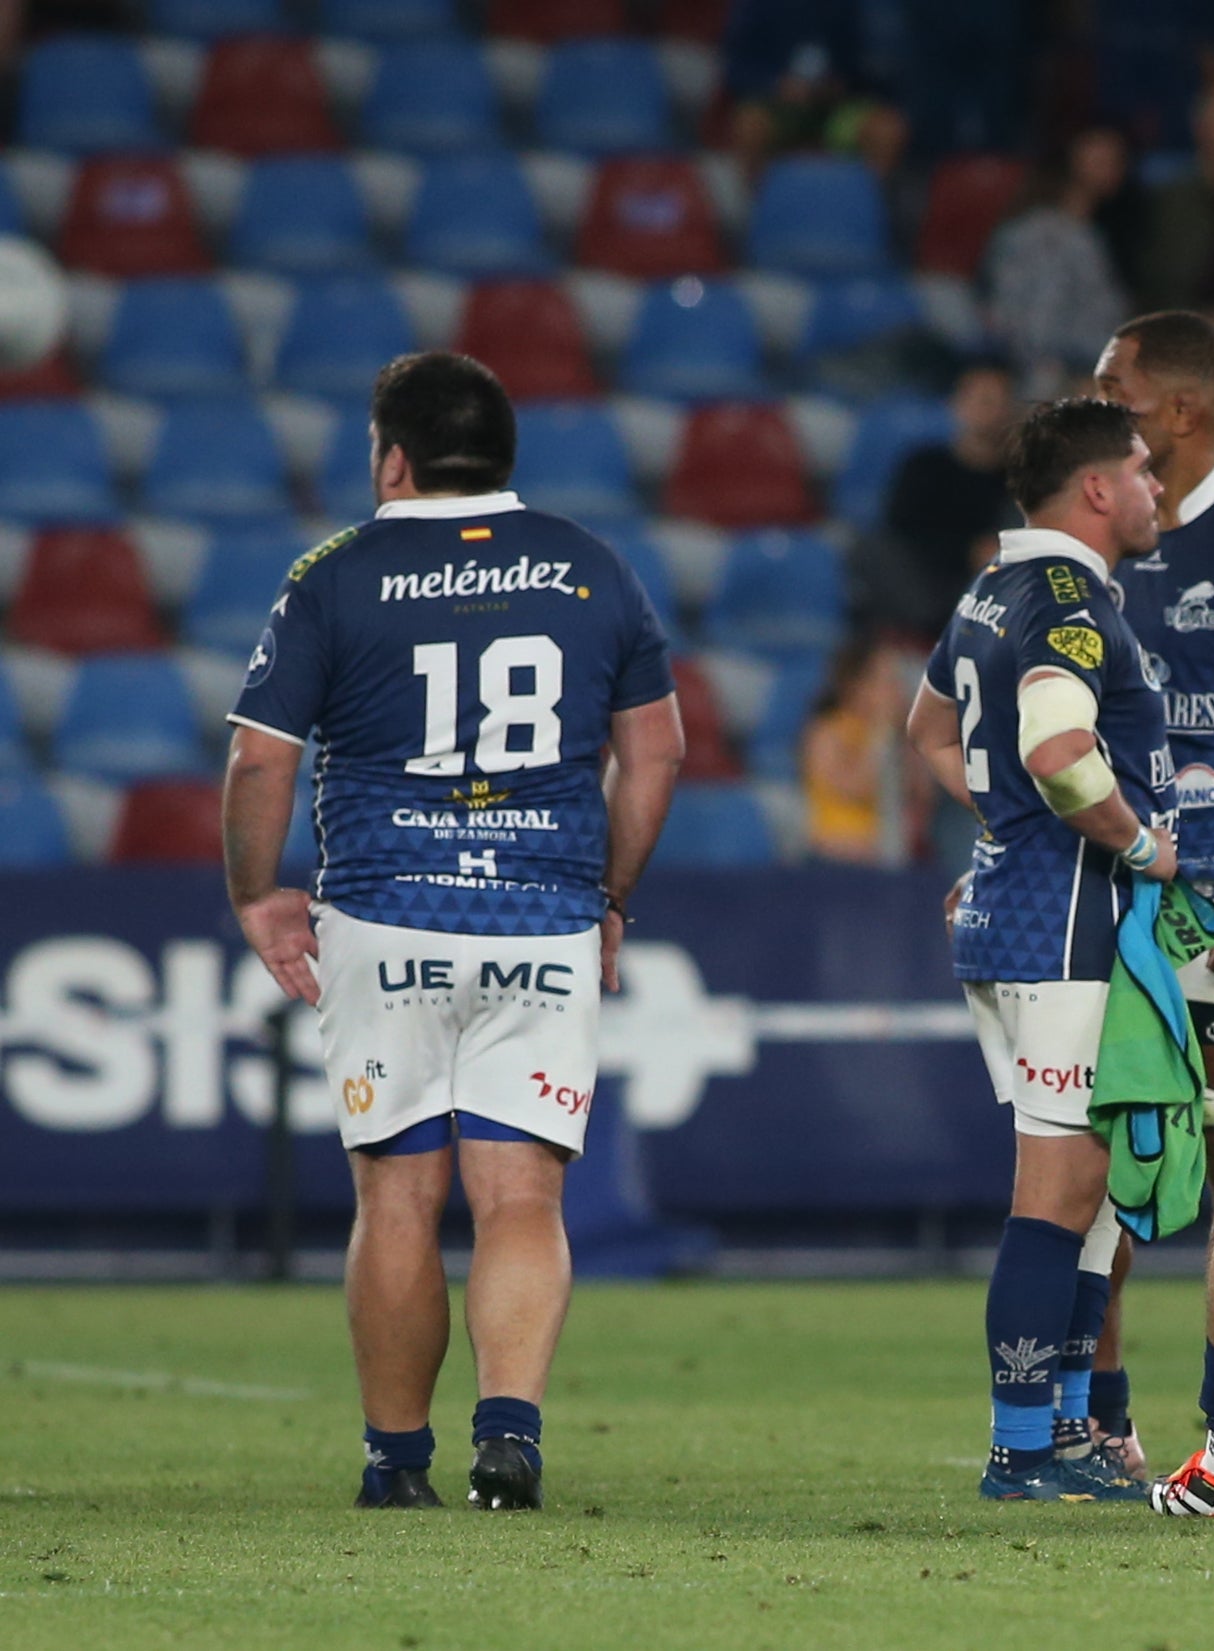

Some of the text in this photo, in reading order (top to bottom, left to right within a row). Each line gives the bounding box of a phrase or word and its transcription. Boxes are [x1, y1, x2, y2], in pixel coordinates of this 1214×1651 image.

[404, 634, 563, 777] 18
[954, 656, 990, 793] 2
[392, 808, 558, 830] CAJA RURAL
[433, 828, 517, 842] DE ZAMORA
[995, 1370, 1049, 1384] CRZ
